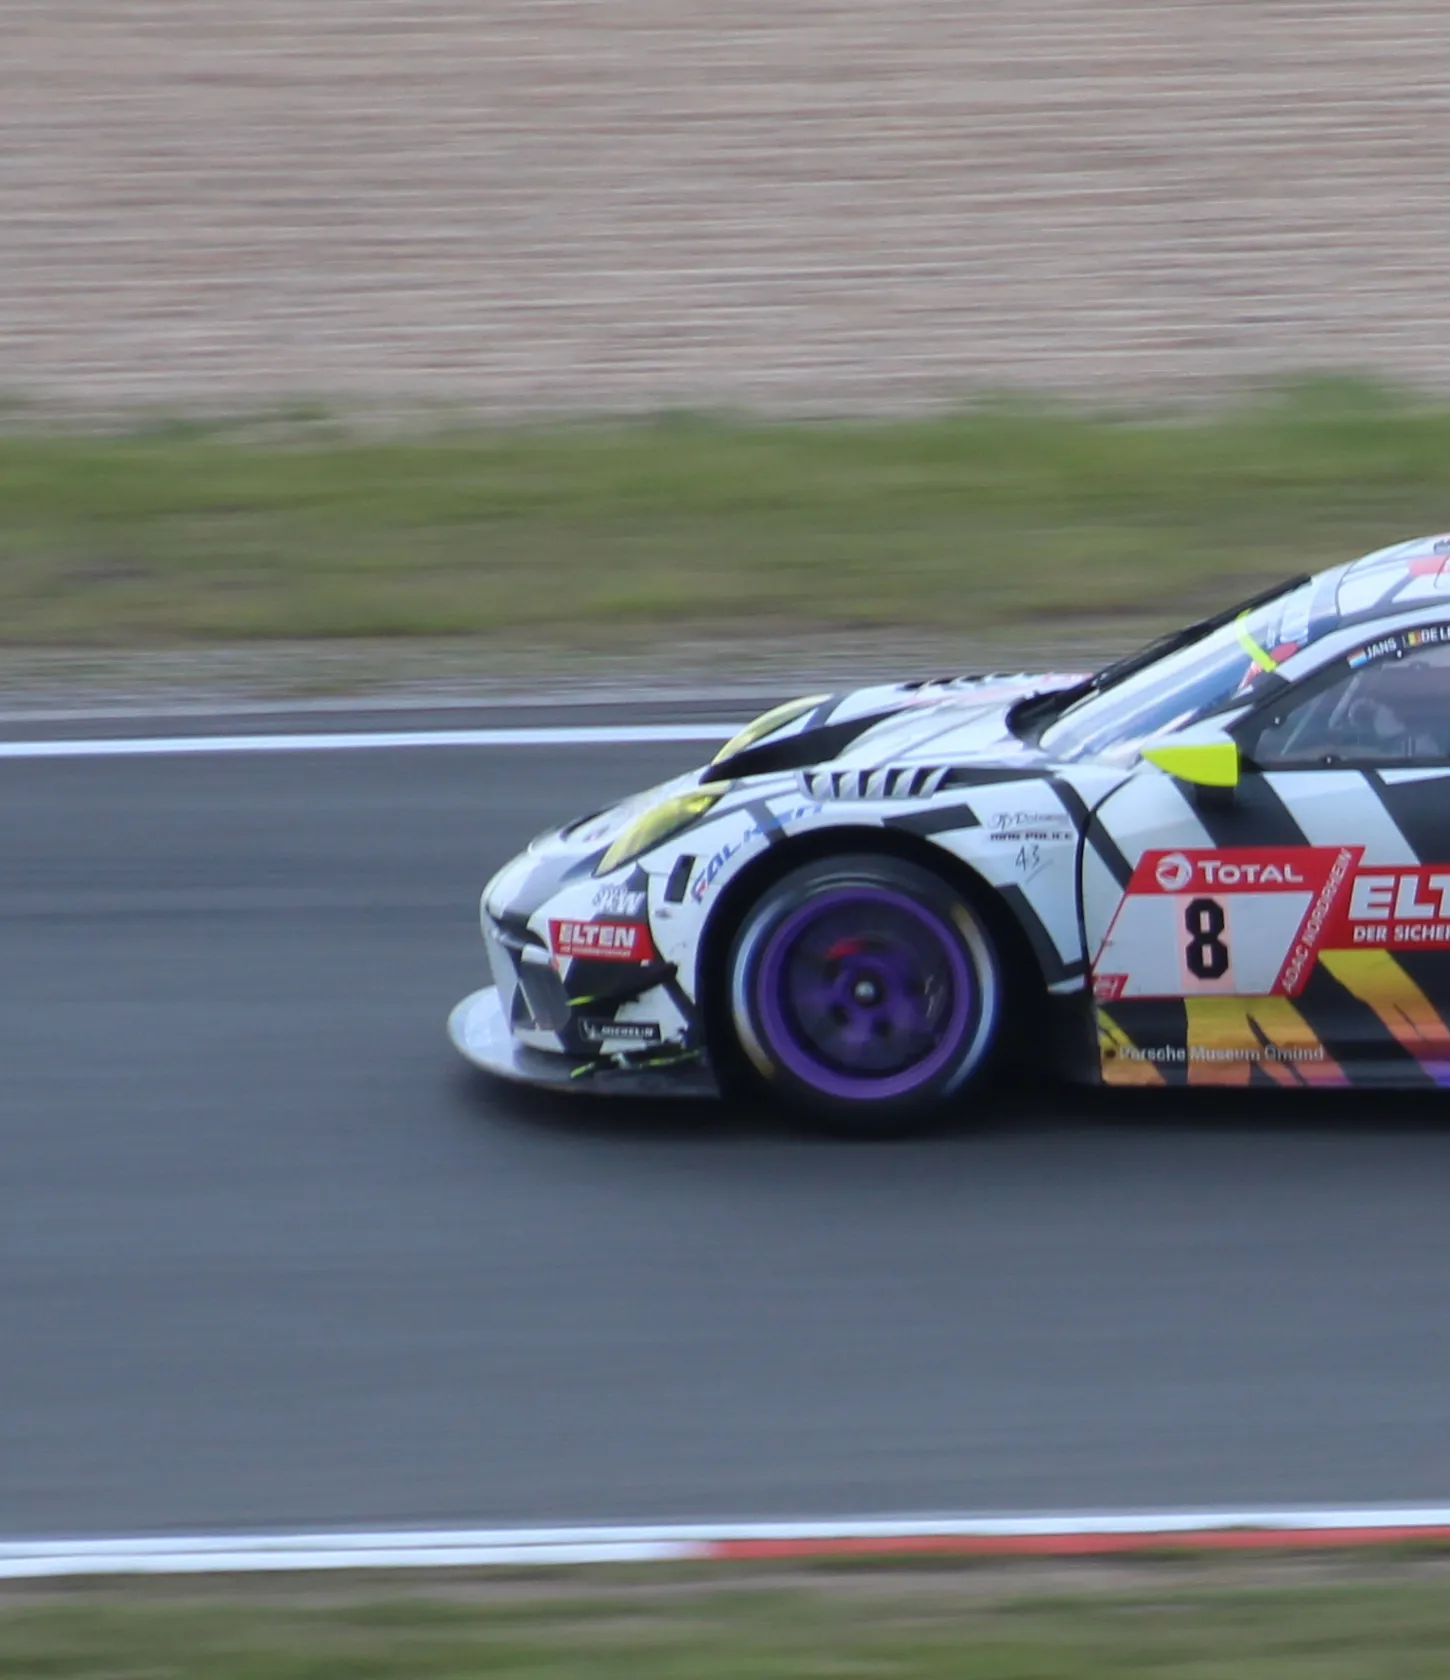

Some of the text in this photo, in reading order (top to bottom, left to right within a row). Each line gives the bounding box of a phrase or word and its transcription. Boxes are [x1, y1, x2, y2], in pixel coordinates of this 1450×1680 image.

[1421, 630, 1438, 643] DE
[1366, 637, 1397, 660] JANS
[558, 922, 637, 948] ELTEN
[1184, 896, 1230, 980] 8
[1353, 924, 1388, 943] DER
[1190, 1044, 1261, 1062] Museum
